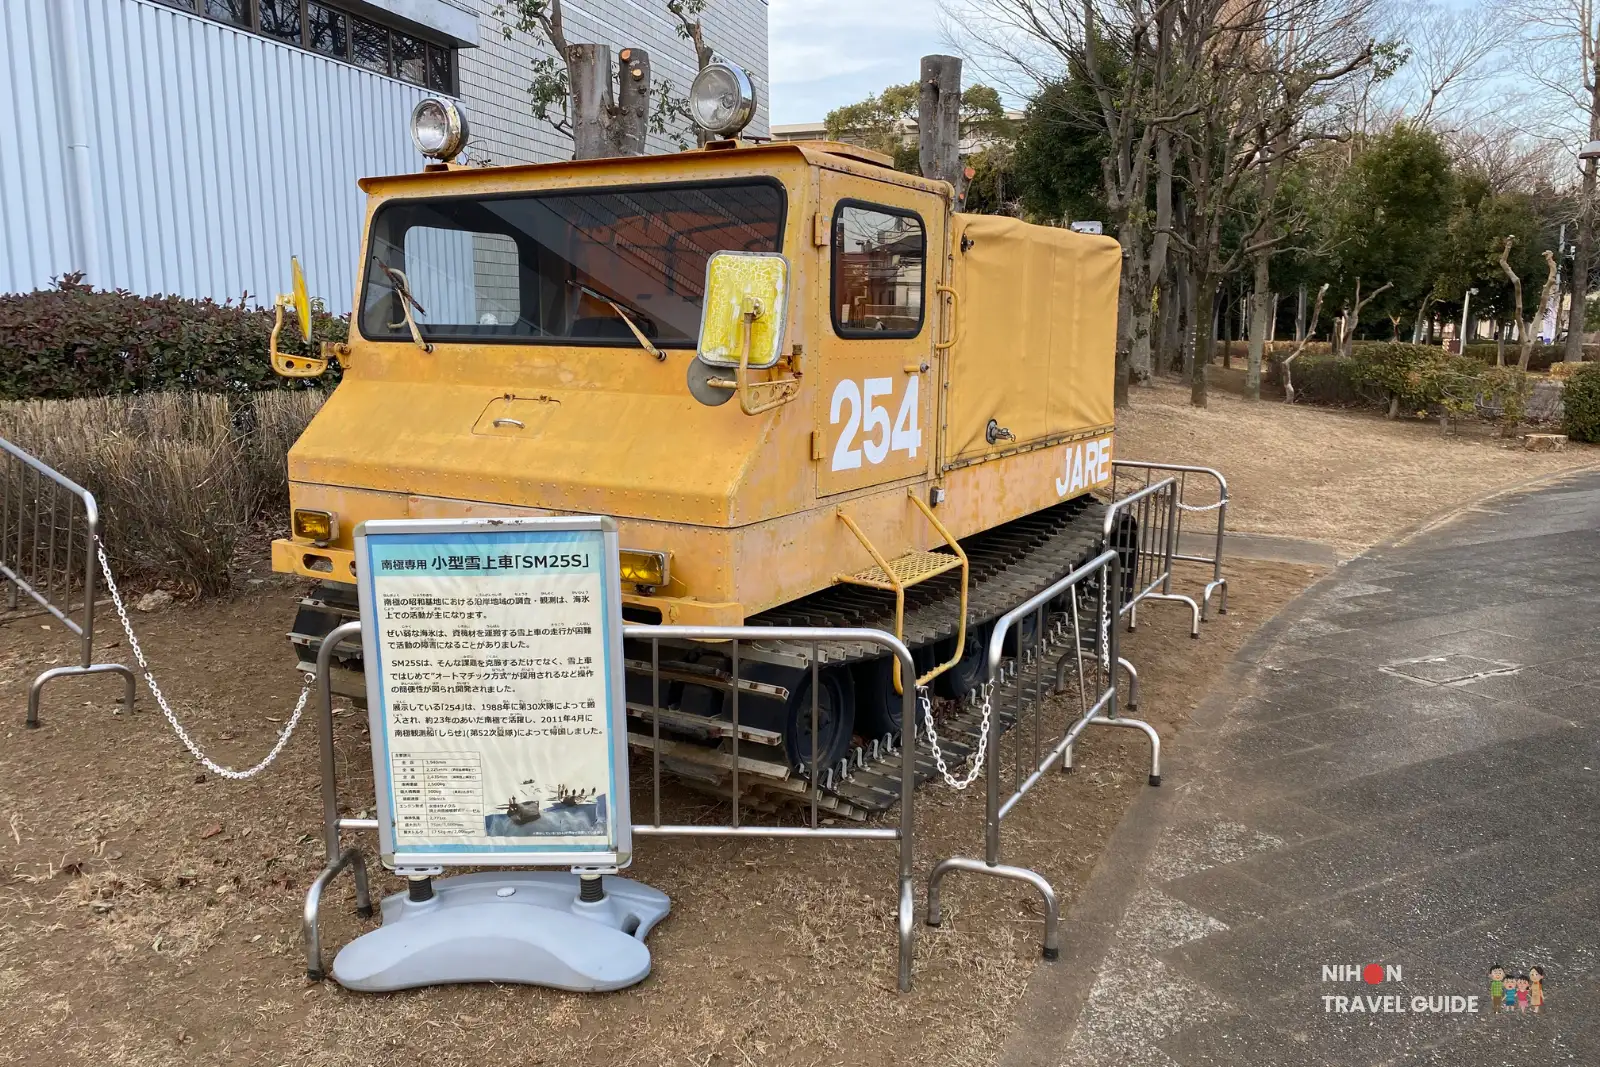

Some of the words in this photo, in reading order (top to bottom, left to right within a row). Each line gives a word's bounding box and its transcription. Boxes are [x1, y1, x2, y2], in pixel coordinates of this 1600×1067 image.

[829, 376, 922, 471] 254
[1056, 437, 1111, 497] JARE
[381, 559, 427, 570] 南極専用
[431, 554, 590, 570] 小型雪上車「SM25S」
